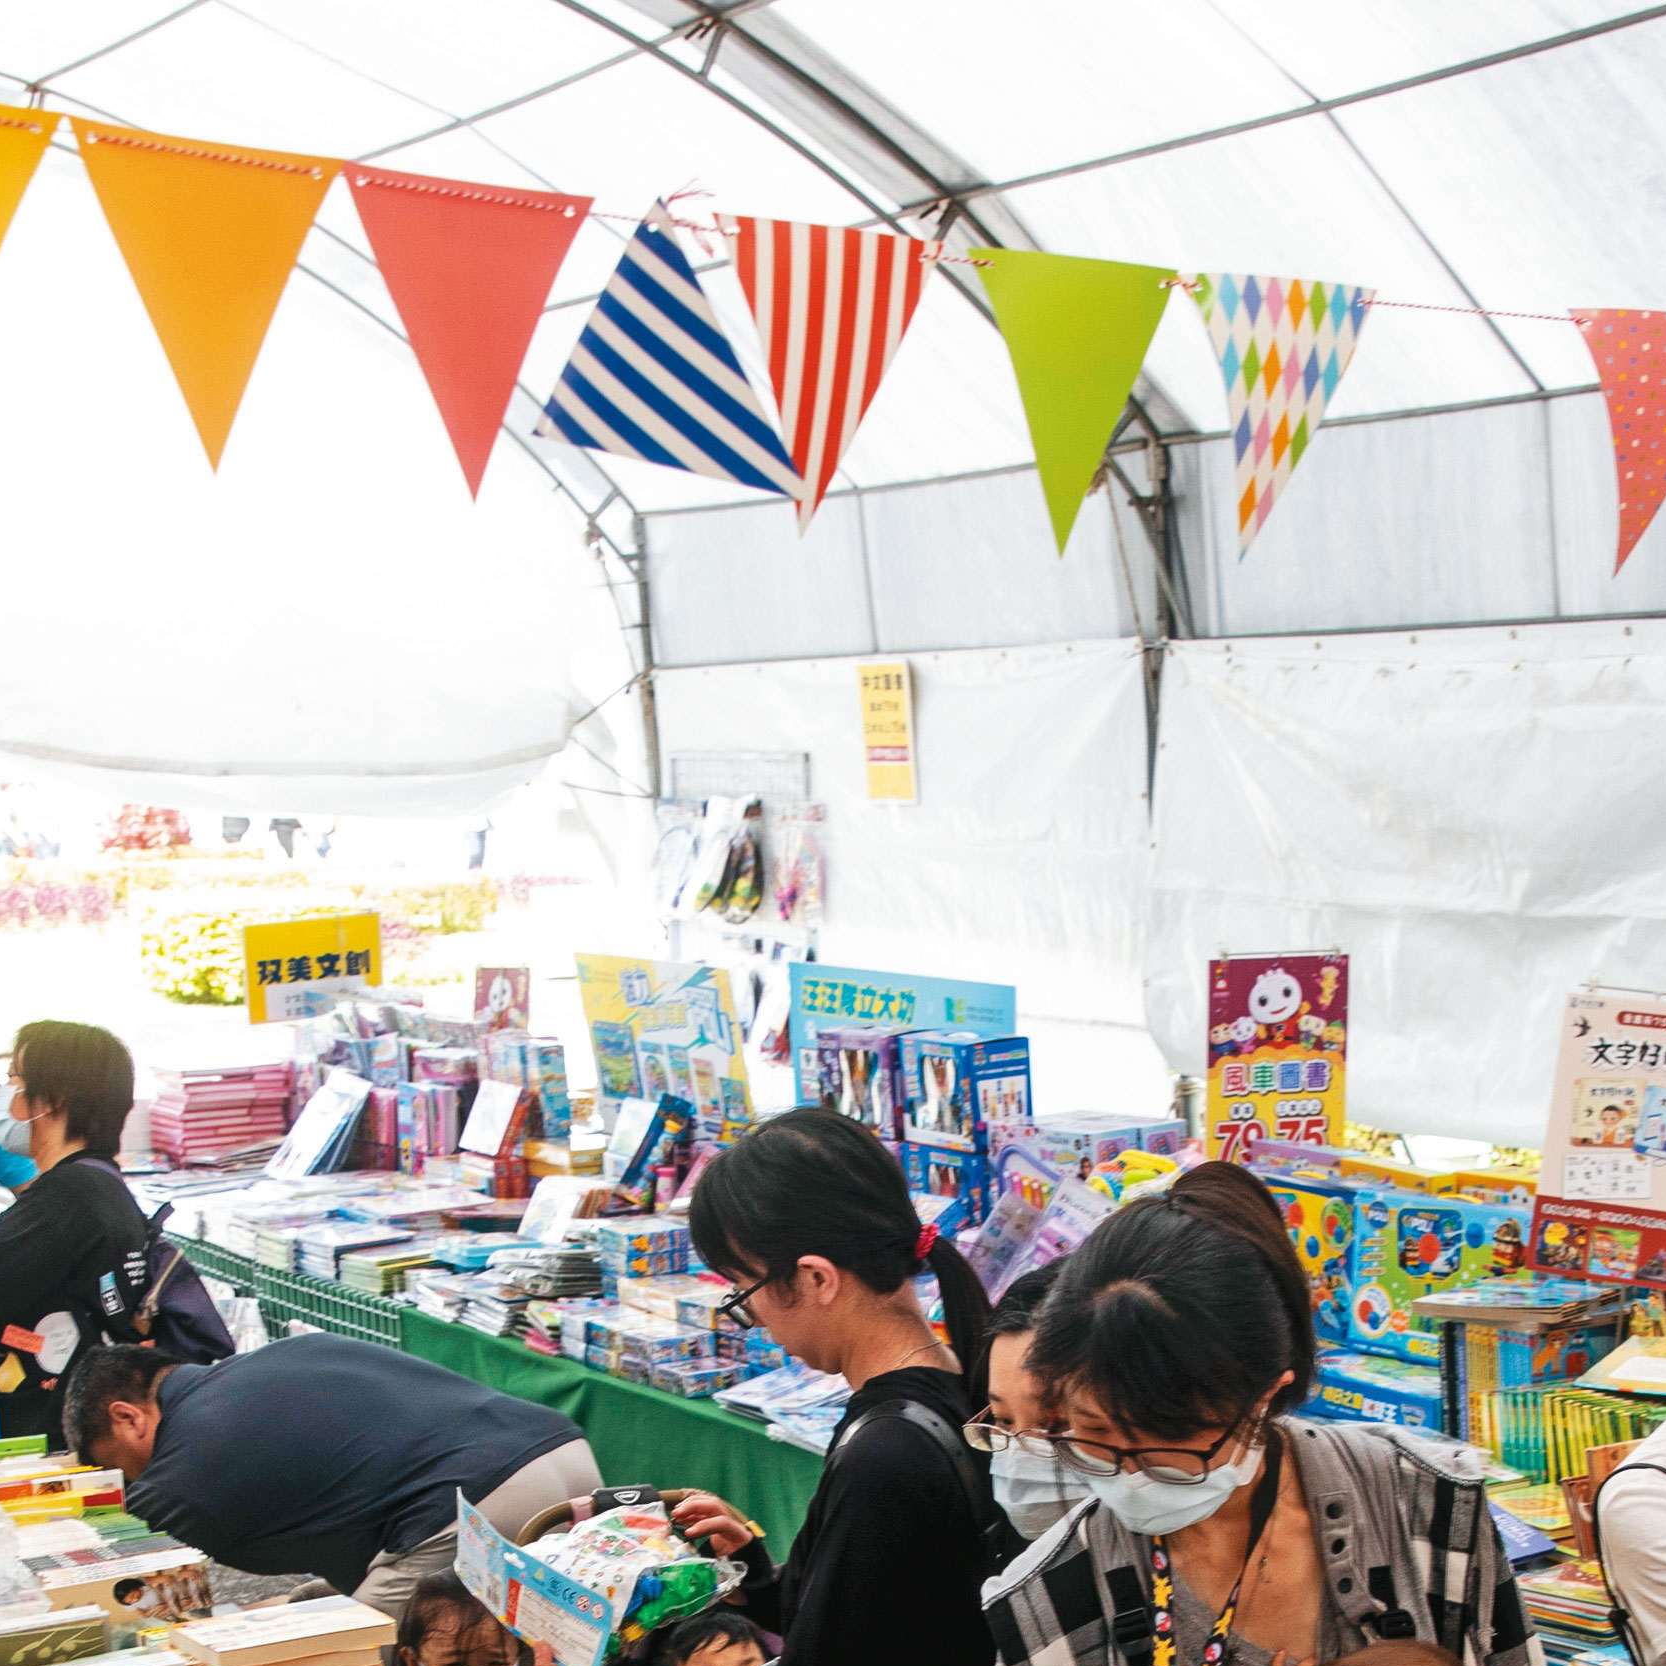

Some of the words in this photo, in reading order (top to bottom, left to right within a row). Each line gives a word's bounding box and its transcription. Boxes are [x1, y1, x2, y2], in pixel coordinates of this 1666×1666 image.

[257, 949, 371, 985] 双美文創
[1223, 1060, 1329, 1095] 風車圖書
[1216, 1120, 1265, 1164] 79
[1276, 1117, 1328, 1147] 75
